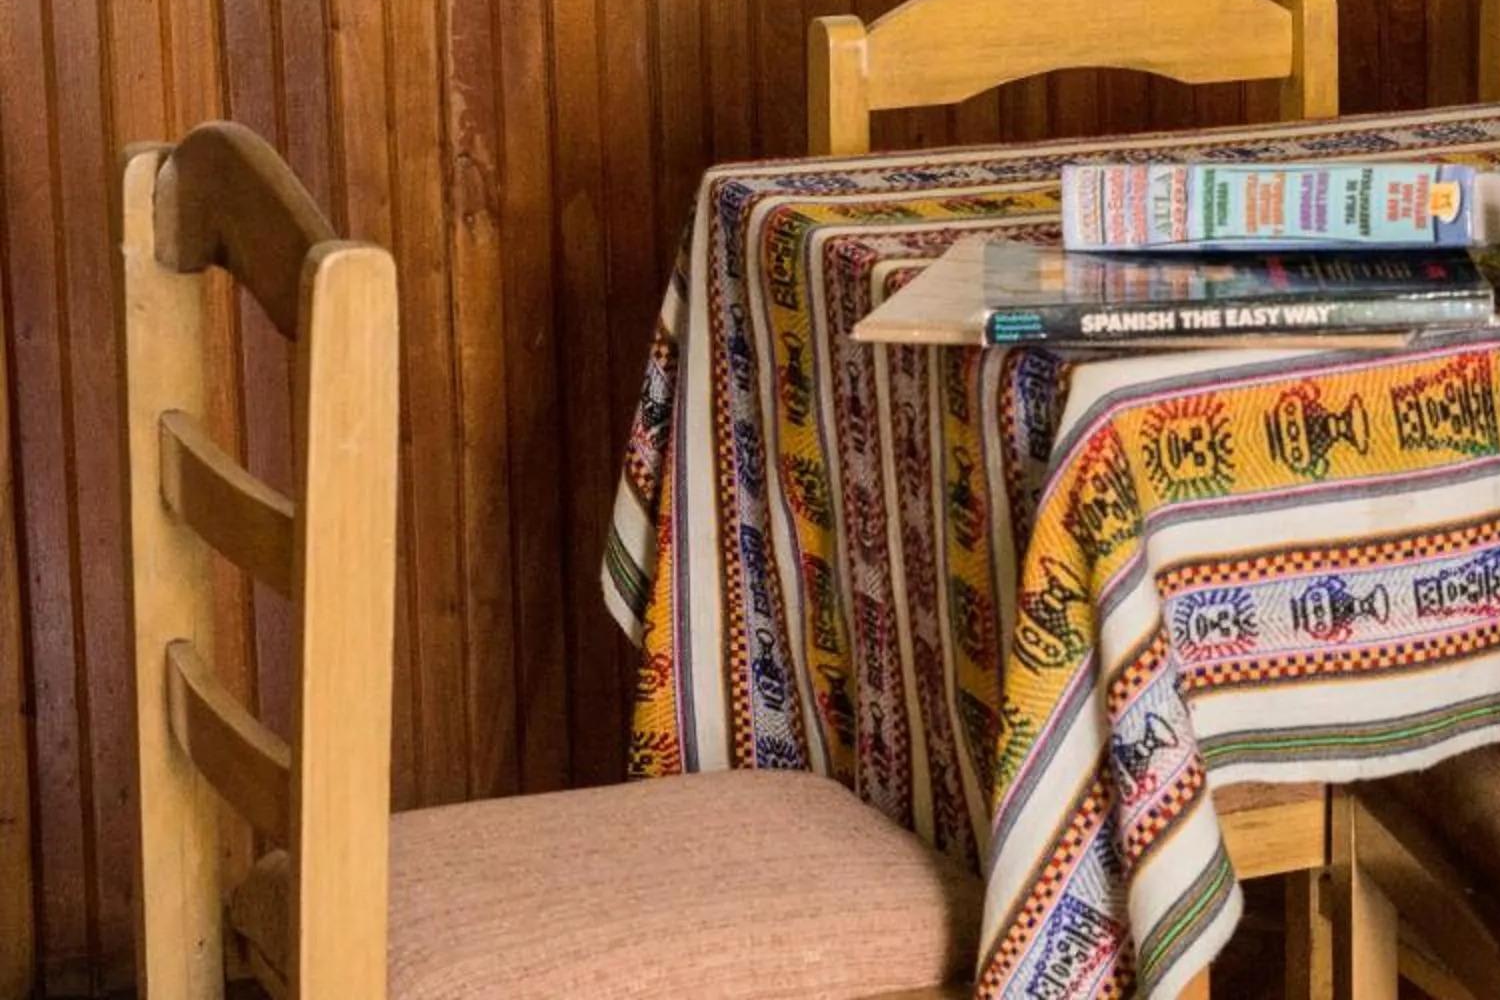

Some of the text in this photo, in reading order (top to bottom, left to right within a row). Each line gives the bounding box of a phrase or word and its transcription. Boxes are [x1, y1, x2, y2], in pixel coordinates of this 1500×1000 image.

[1081, 312, 1175, 334] SPANISH
[1179, 309, 1221, 329] THE
[1225, 307, 1279, 327] EASY
